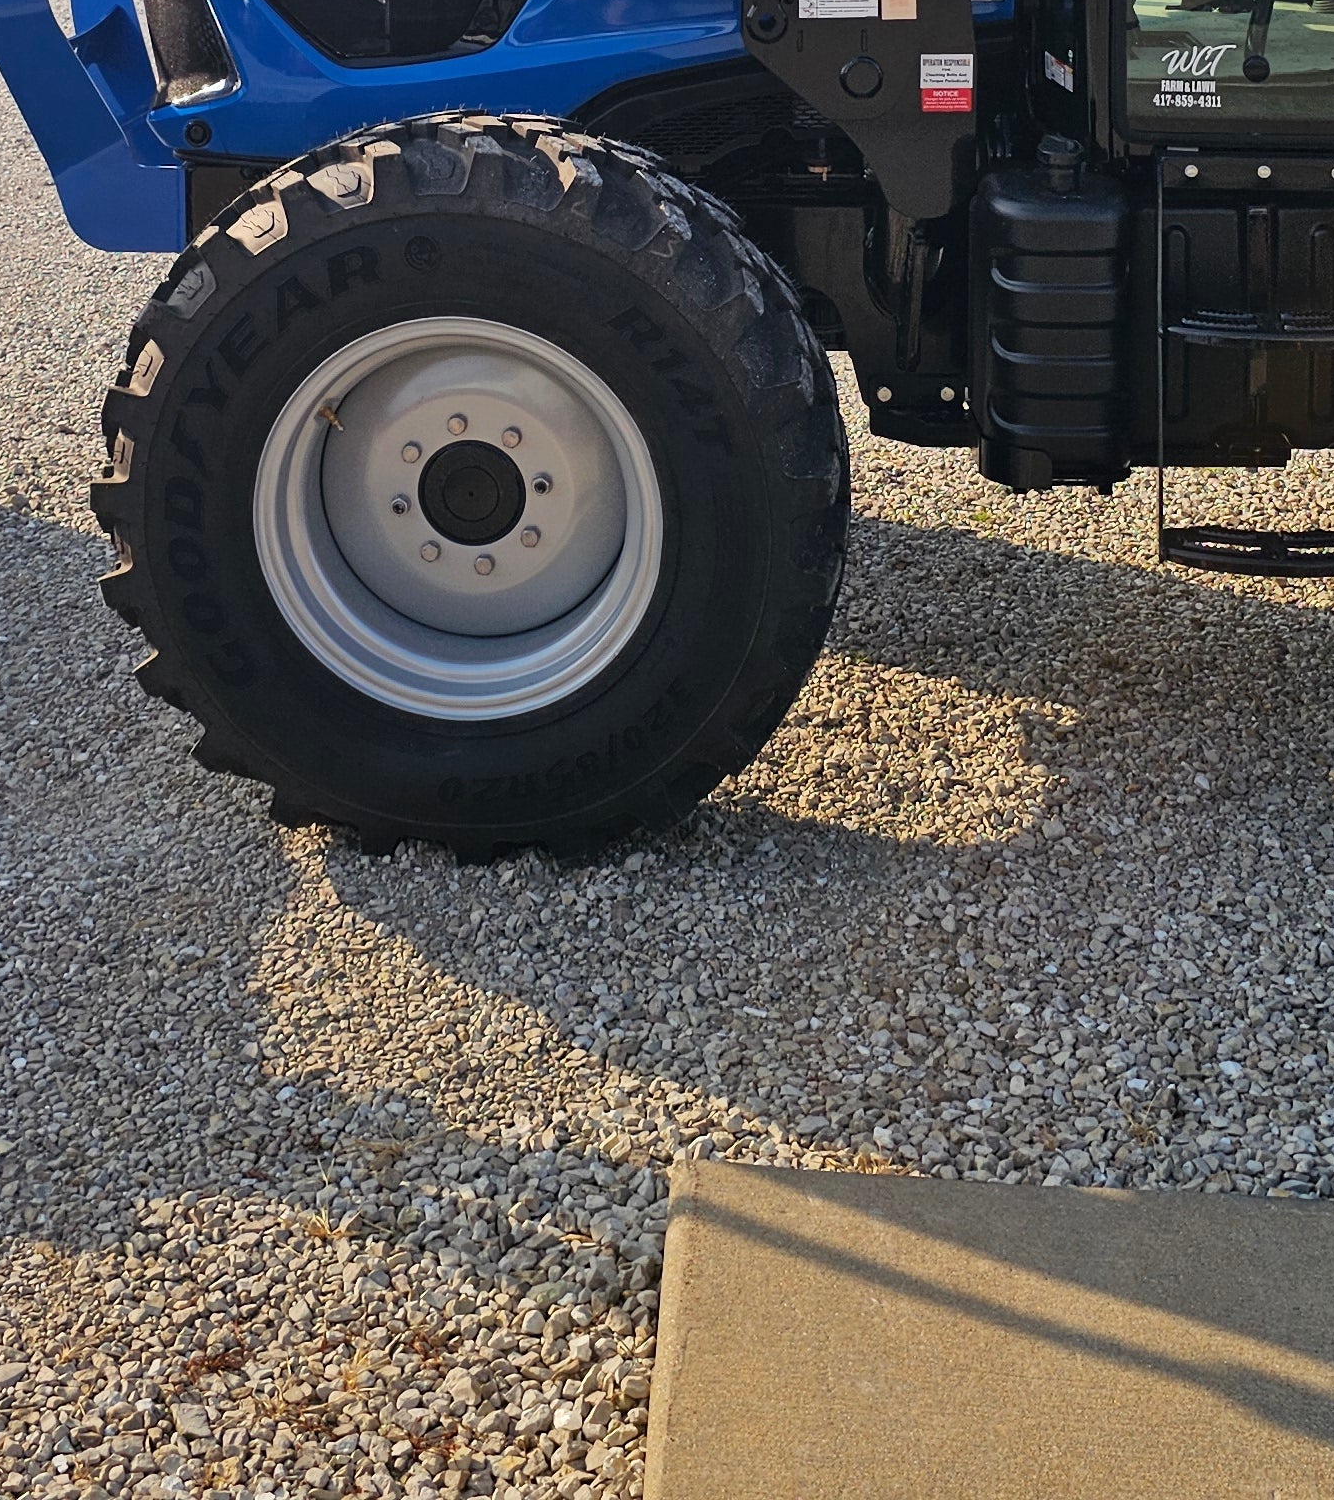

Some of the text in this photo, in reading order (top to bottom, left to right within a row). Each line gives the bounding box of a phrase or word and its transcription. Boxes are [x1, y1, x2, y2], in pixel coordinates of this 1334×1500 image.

[1161, 44, 1237, 77] WCT
[1161, 80, 1216, 93] FARM & LAWN
[164, 242, 382, 690] GOODYEAR
